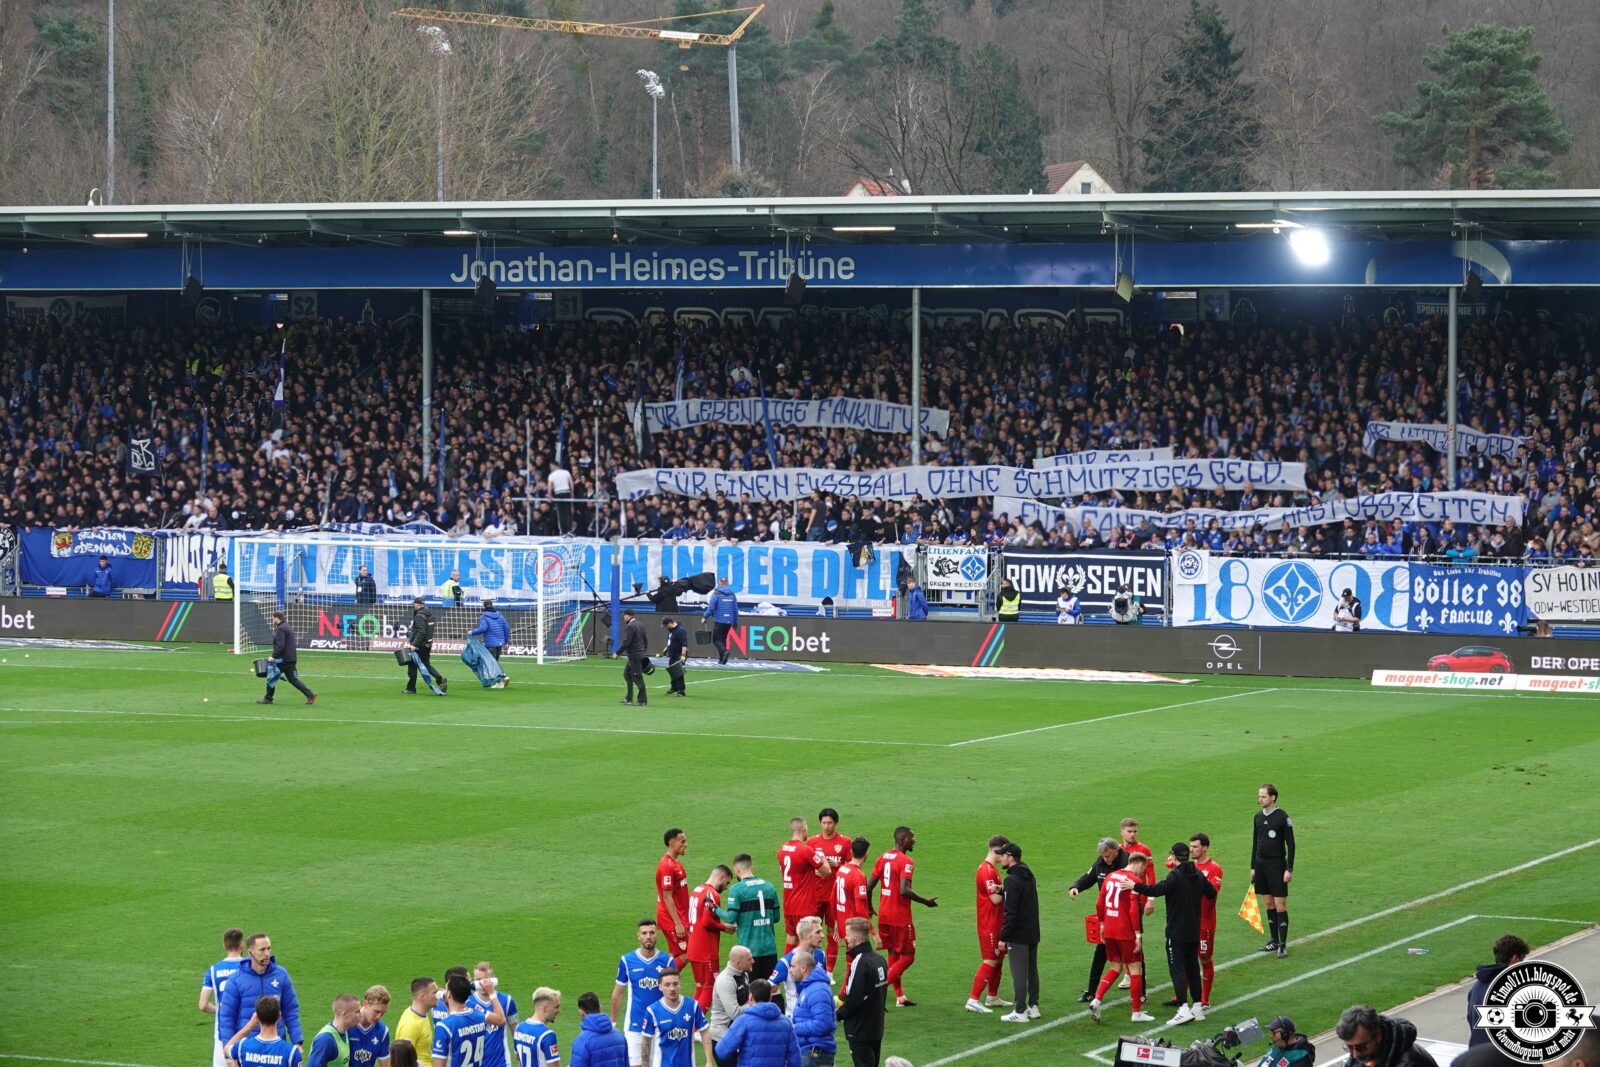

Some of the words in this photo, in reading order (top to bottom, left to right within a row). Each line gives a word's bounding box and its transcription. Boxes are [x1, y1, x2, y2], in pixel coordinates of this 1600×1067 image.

[449, 250, 855, 285] Jonathan-Heimes-Tribüne
[656, 470, 708, 495] FÜR
[715, 473, 790, 499] EINEN
[796, 472, 918, 498] FUSSBALL
[928, 469, 1000, 494] OHNE
[1014, 464, 1205, 496] SCHMUTZIGES
[1211, 461, 1287, 485] GELD.
[928, 547, 987, 555] LILIENFANS
[716, 546, 799, 597] DER
[1006, 564, 1056, 593] ROW
[1087, 565, 1162, 598] SEVEN
[1532, 573, 1551, 593] SV
[1413, 575, 1488, 607] Böller
[1496, 579, 1523, 609] 98
[372, 641, 402, 649] SMART
[1206, 662, 1242, 670] OPEL
[1531, 656, 1564, 669] DER
[1384, 672, 1504, 687] magnet-shop.net
[783, 855, 792, 882] 2
[883, 861, 891, 888] 9
[757, 890, 766, 918] 1
[245, 1051, 284, 1066] DARMSTADT
[460, 1035, 485, 1067] 24
